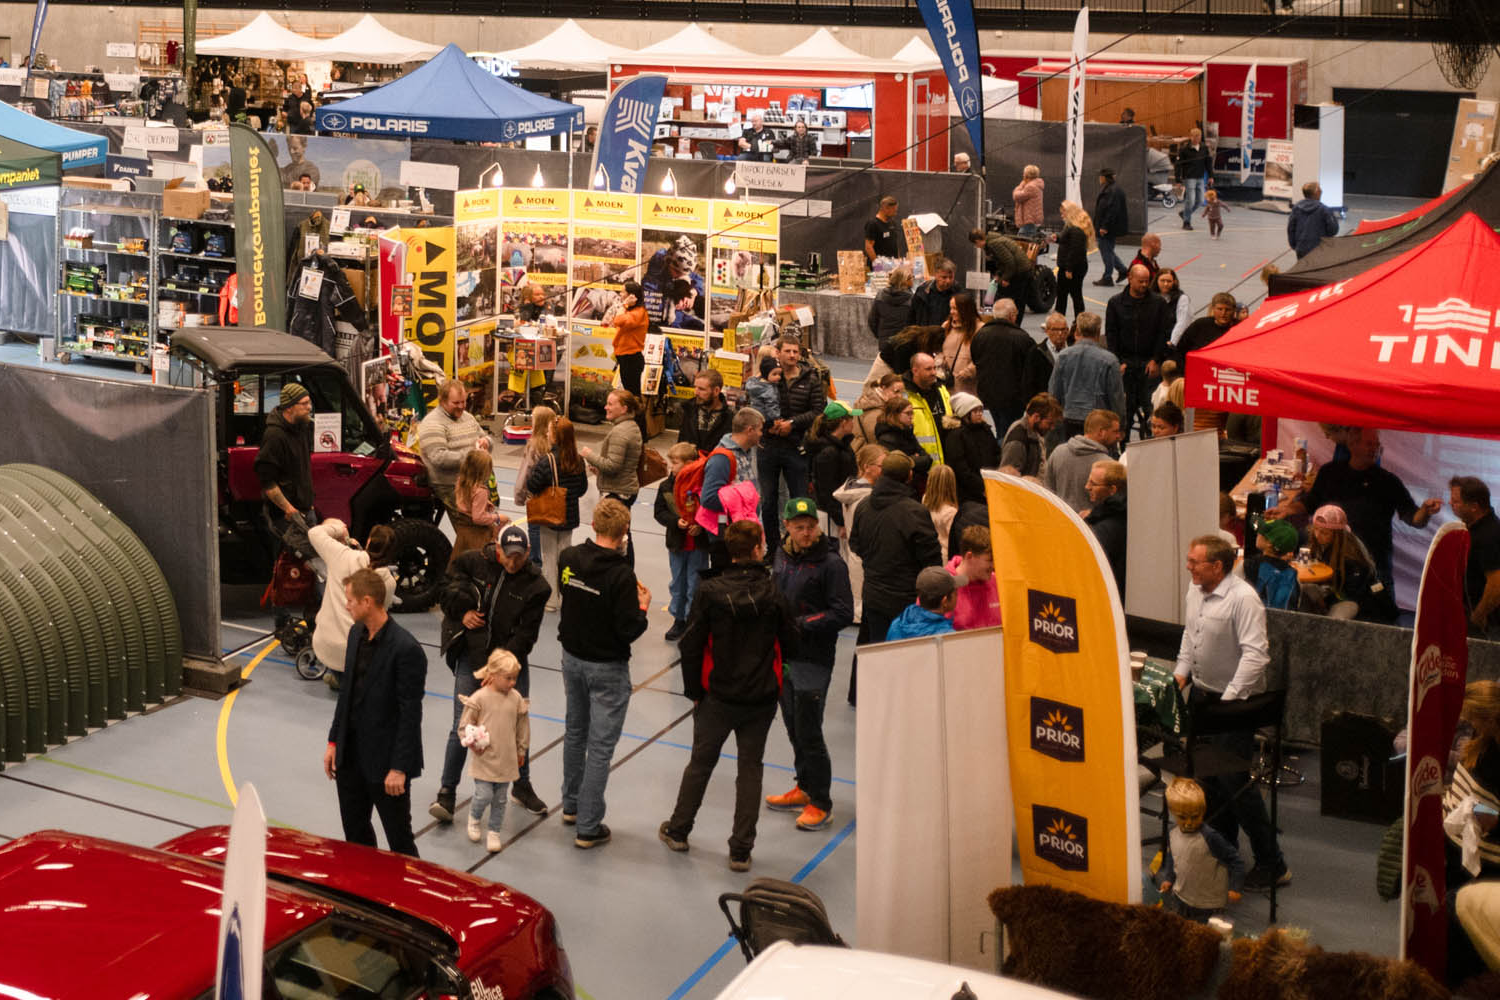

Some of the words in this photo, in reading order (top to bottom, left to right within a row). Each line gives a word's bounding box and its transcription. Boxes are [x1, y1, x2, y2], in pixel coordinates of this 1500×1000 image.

[351, 117, 430, 134] POLARIS
[517, 118, 556, 134] POLARIS
[62, 147, 99, 162] PUMPER
[526, 197, 555, 205] MOEN
[596, 200, 624, 209] MOEN
[665, 205, 694, 215] MOEN
[736, 210, 764, 220] MOEN
[1203, 384, 1260, 407] TINE
[1034, 617, 1075, 641] PRIOR
[1036, 726, 1080, 750] PRIOR
[1039, 833, 1084, 859] PRIOR
